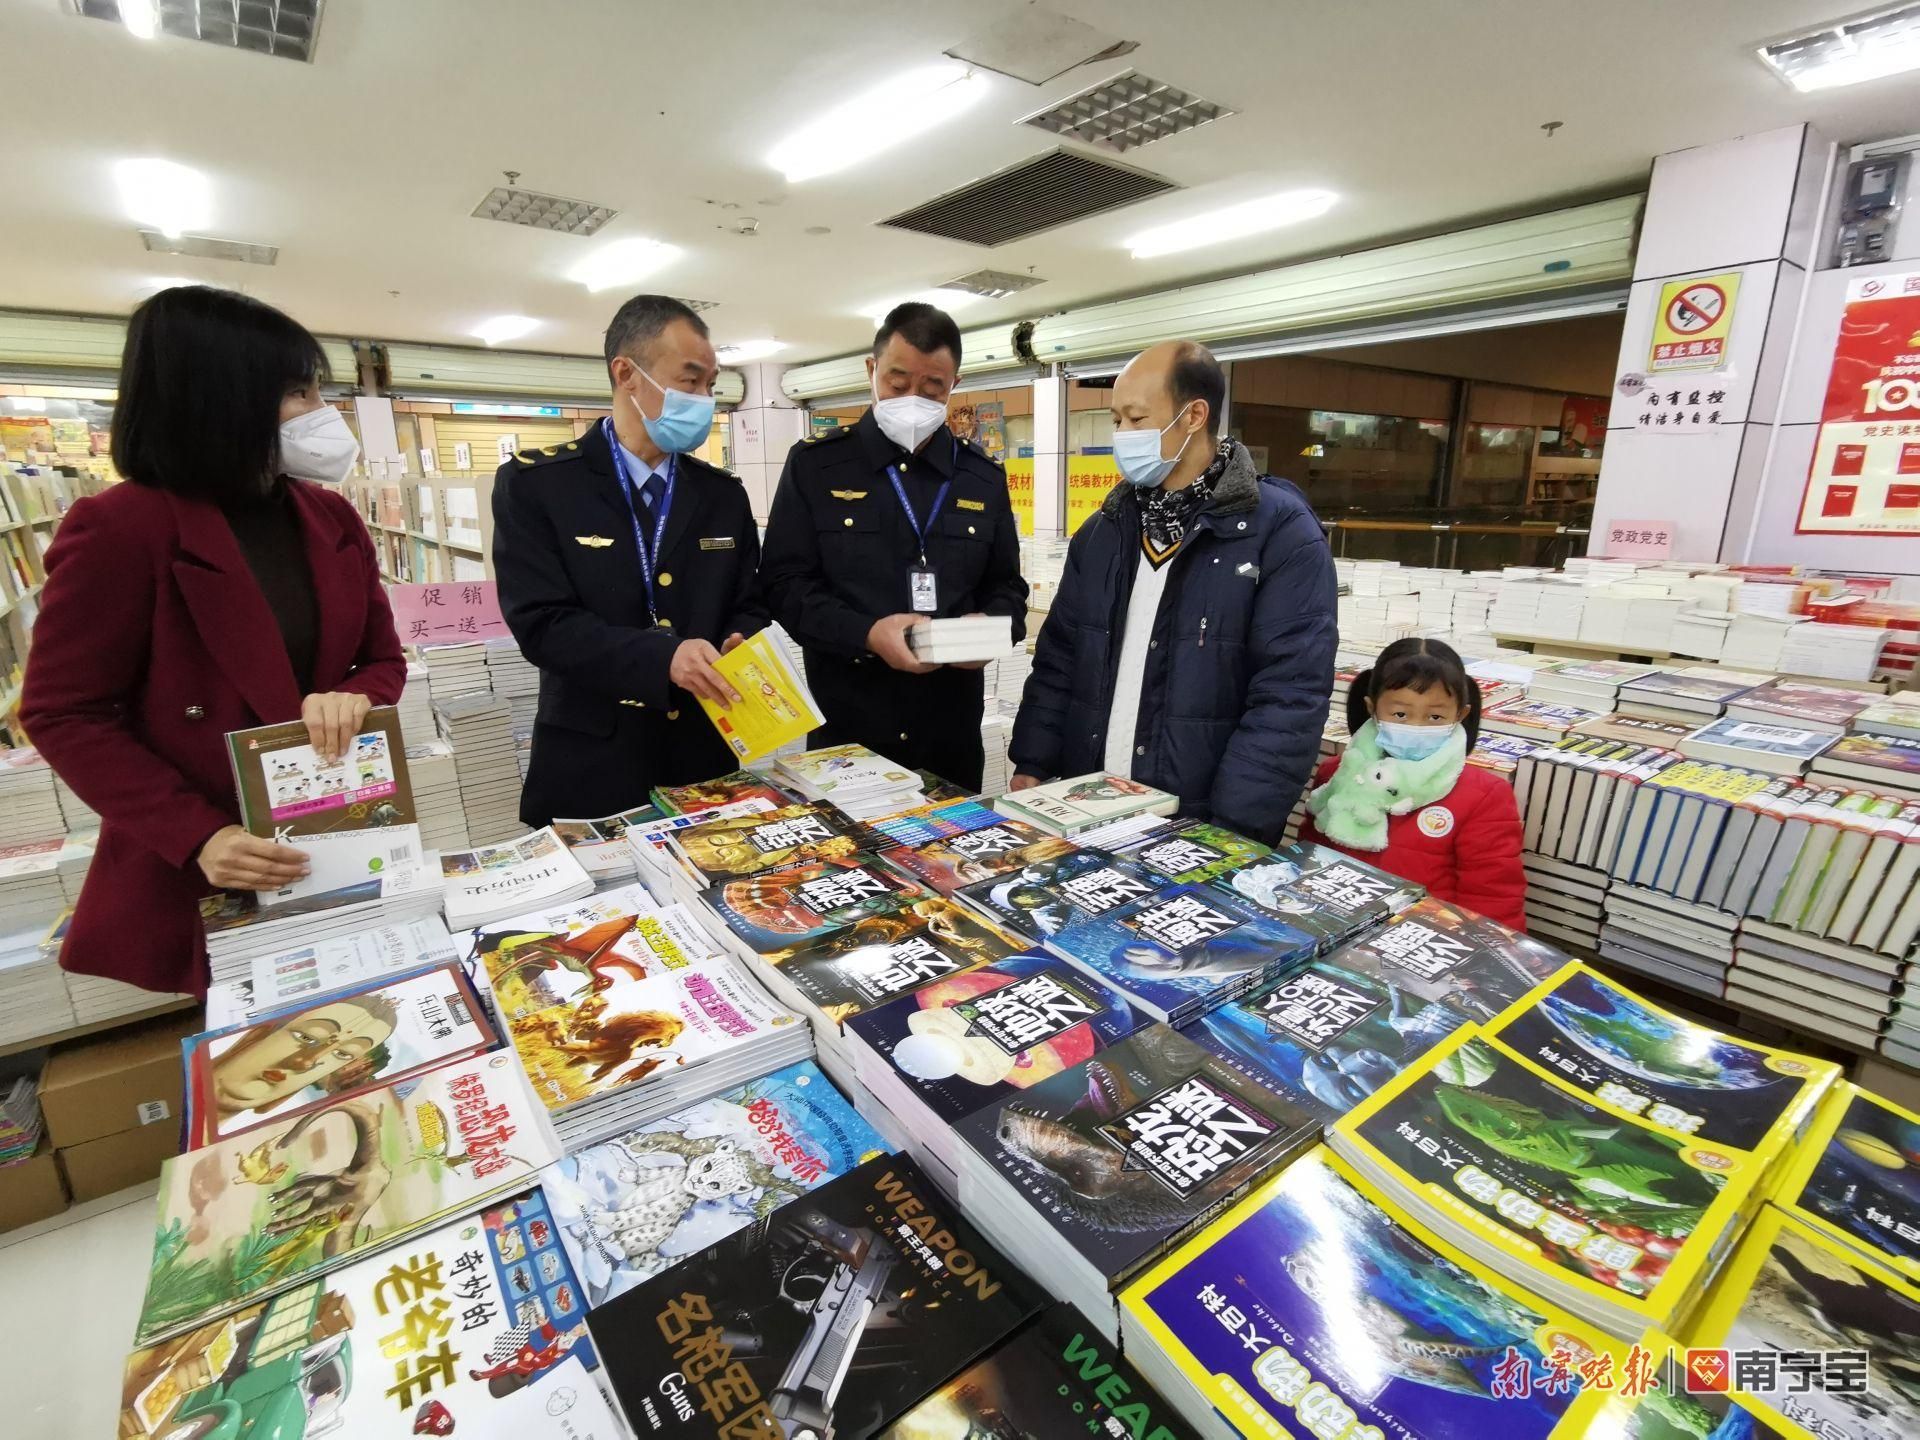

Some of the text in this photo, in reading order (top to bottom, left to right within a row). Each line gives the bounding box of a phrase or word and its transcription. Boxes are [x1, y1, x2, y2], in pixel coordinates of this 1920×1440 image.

[1657, 341, 1720, 359] 禁止烟火
[1639, 410, 1722, 426] 请洁身自爱
[1646, 389, 1726, 406] 内有监控
[1611, 528, 1668, 546] 党政党史
[420, 586, 482, 608] 促销
[409, 616, 502, 639] 买一送一
[752, 819, 803, 850] 宝藏
[783, 813, 833, 843] 之谜
[975, 824, 1030, 851] 之谜
[1142, 844, 1200, 873] 自然
[1161, 836, 1222, 865] 之谜
[797, 876, 859, 910] 动物
[829, 867, 891, 901] 之谜
[1056, 874, 1129, 911] 宇宙
[1082, 866, 1154, 901] 之谜
[1302, 869, 1376, 912] 科学
[1323, 860, 1397, 901] 之谜
[1130, 905, 1214, 946] 海洋
[1158, 894, 1240, 934] 之谜
[1367, 931, 1456, 975] 兵器
[1388, 919, 1476, 961] 之谜
[1006, 974, 1098, 1028] 之谜
[1275, 981, 1360, 1026] 与UFO
[1292, 970, 1380, 1016] 之谜
[970, 988, 1062, 1045] 地球
[974, 1014, 1023, 1049] 你不可不知的
[1256, 990, 1345, 1039] 外星人
[1267, 1012, 1324, 1044] 你不可不知的
[1155, 1078, 1272, 1157] 之谜
[1118, 1100, 1235, 1183] 恐龙
[1128, 1138, 1194, 1188] 你不可不知的
[995, 1150, 1074, 1224] 少年探索发现系列
[865, 1204, 952, 1299] DOMINANCE
[874, 1171, 1001, 1301] WEAPON
[897, 1223, 946, 1272] 霸王兵器
[450, 1249, 498, 1332] 奇妙的
[373, 1251, 463, 1412] 老爷车
[1250, 1302, 1296, 1348] Dabaike
[658, 1372, 696, 1423] Guns
[1062, 1332, 1178, 1440] WEA
